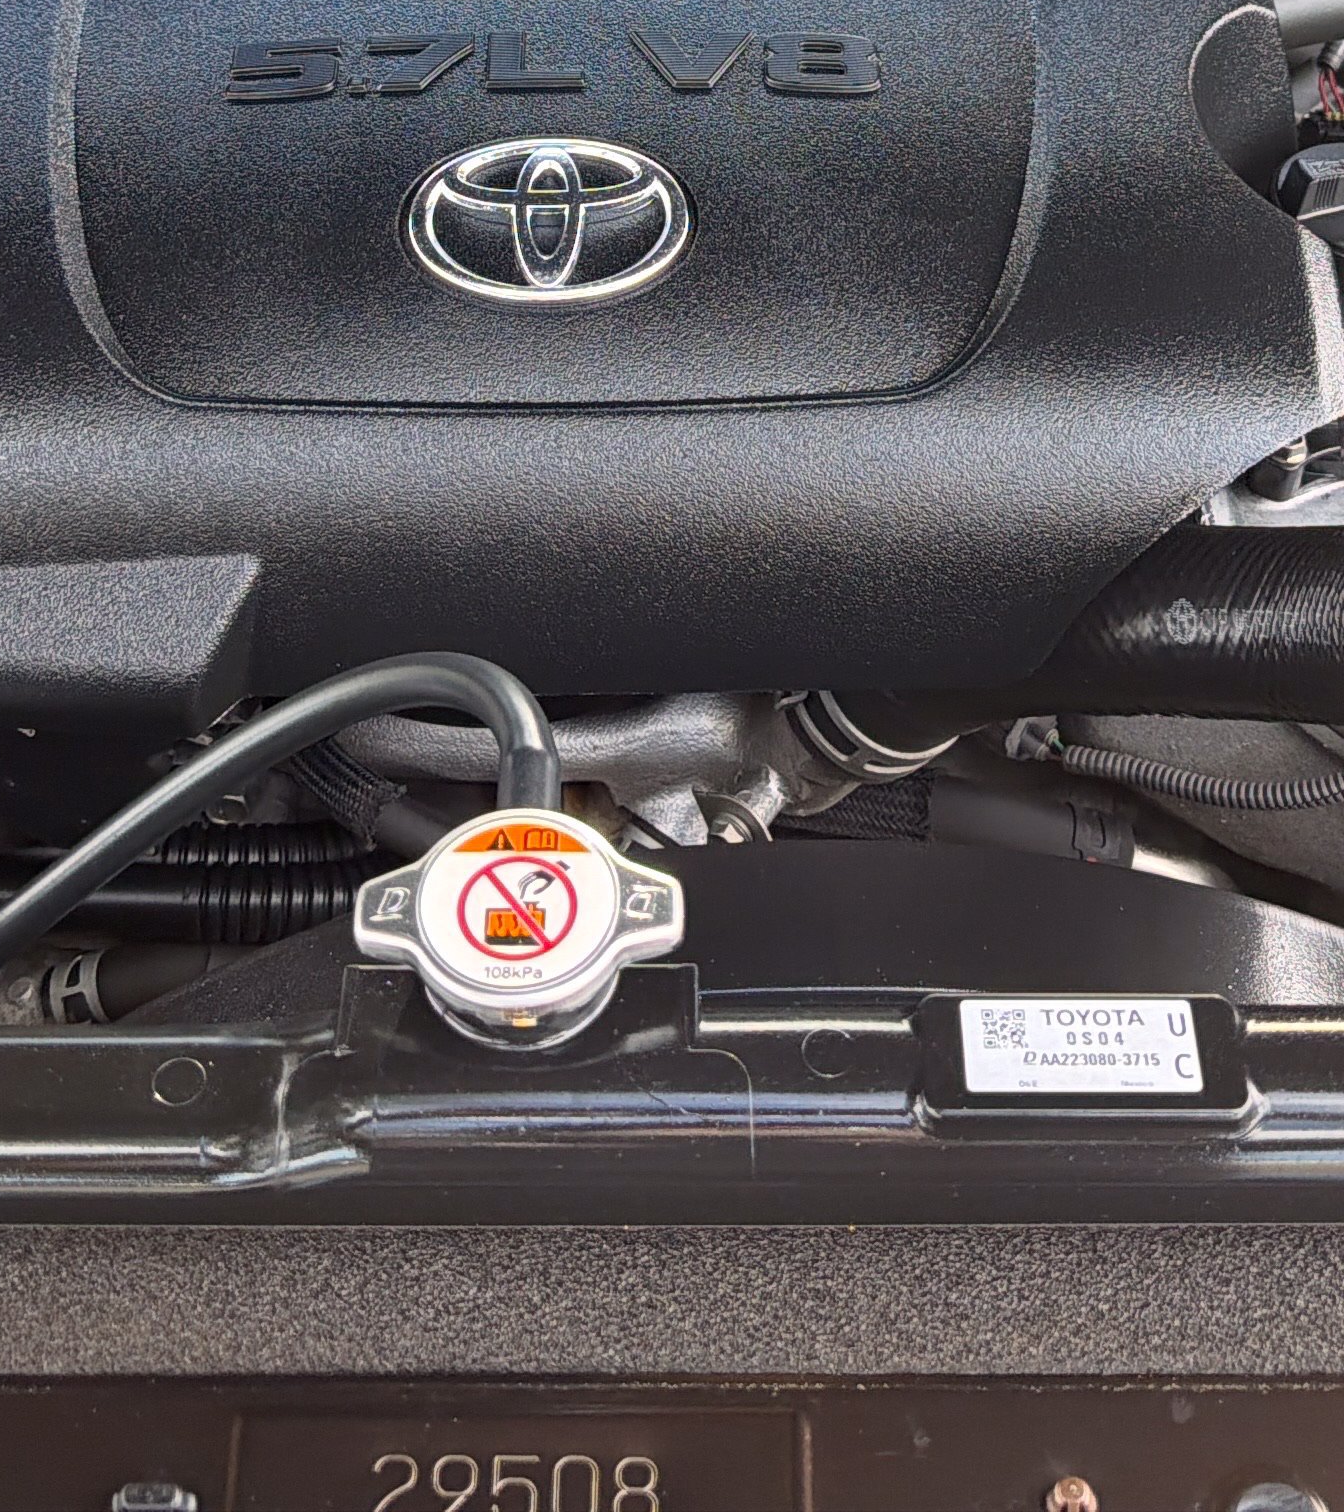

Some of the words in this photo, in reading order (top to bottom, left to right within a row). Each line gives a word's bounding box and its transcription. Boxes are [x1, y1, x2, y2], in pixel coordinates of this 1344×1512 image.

[225, 32, 586, 99] 5.7L
[628, 30, 881, 94] V8
[484, 965, 543, 980] 108kPa
[1039, 1008, 1146, 1027] TOYOTA
[1167, 1012, 1188, 1037] U
[1174, 1053, 1195, 1079] C
